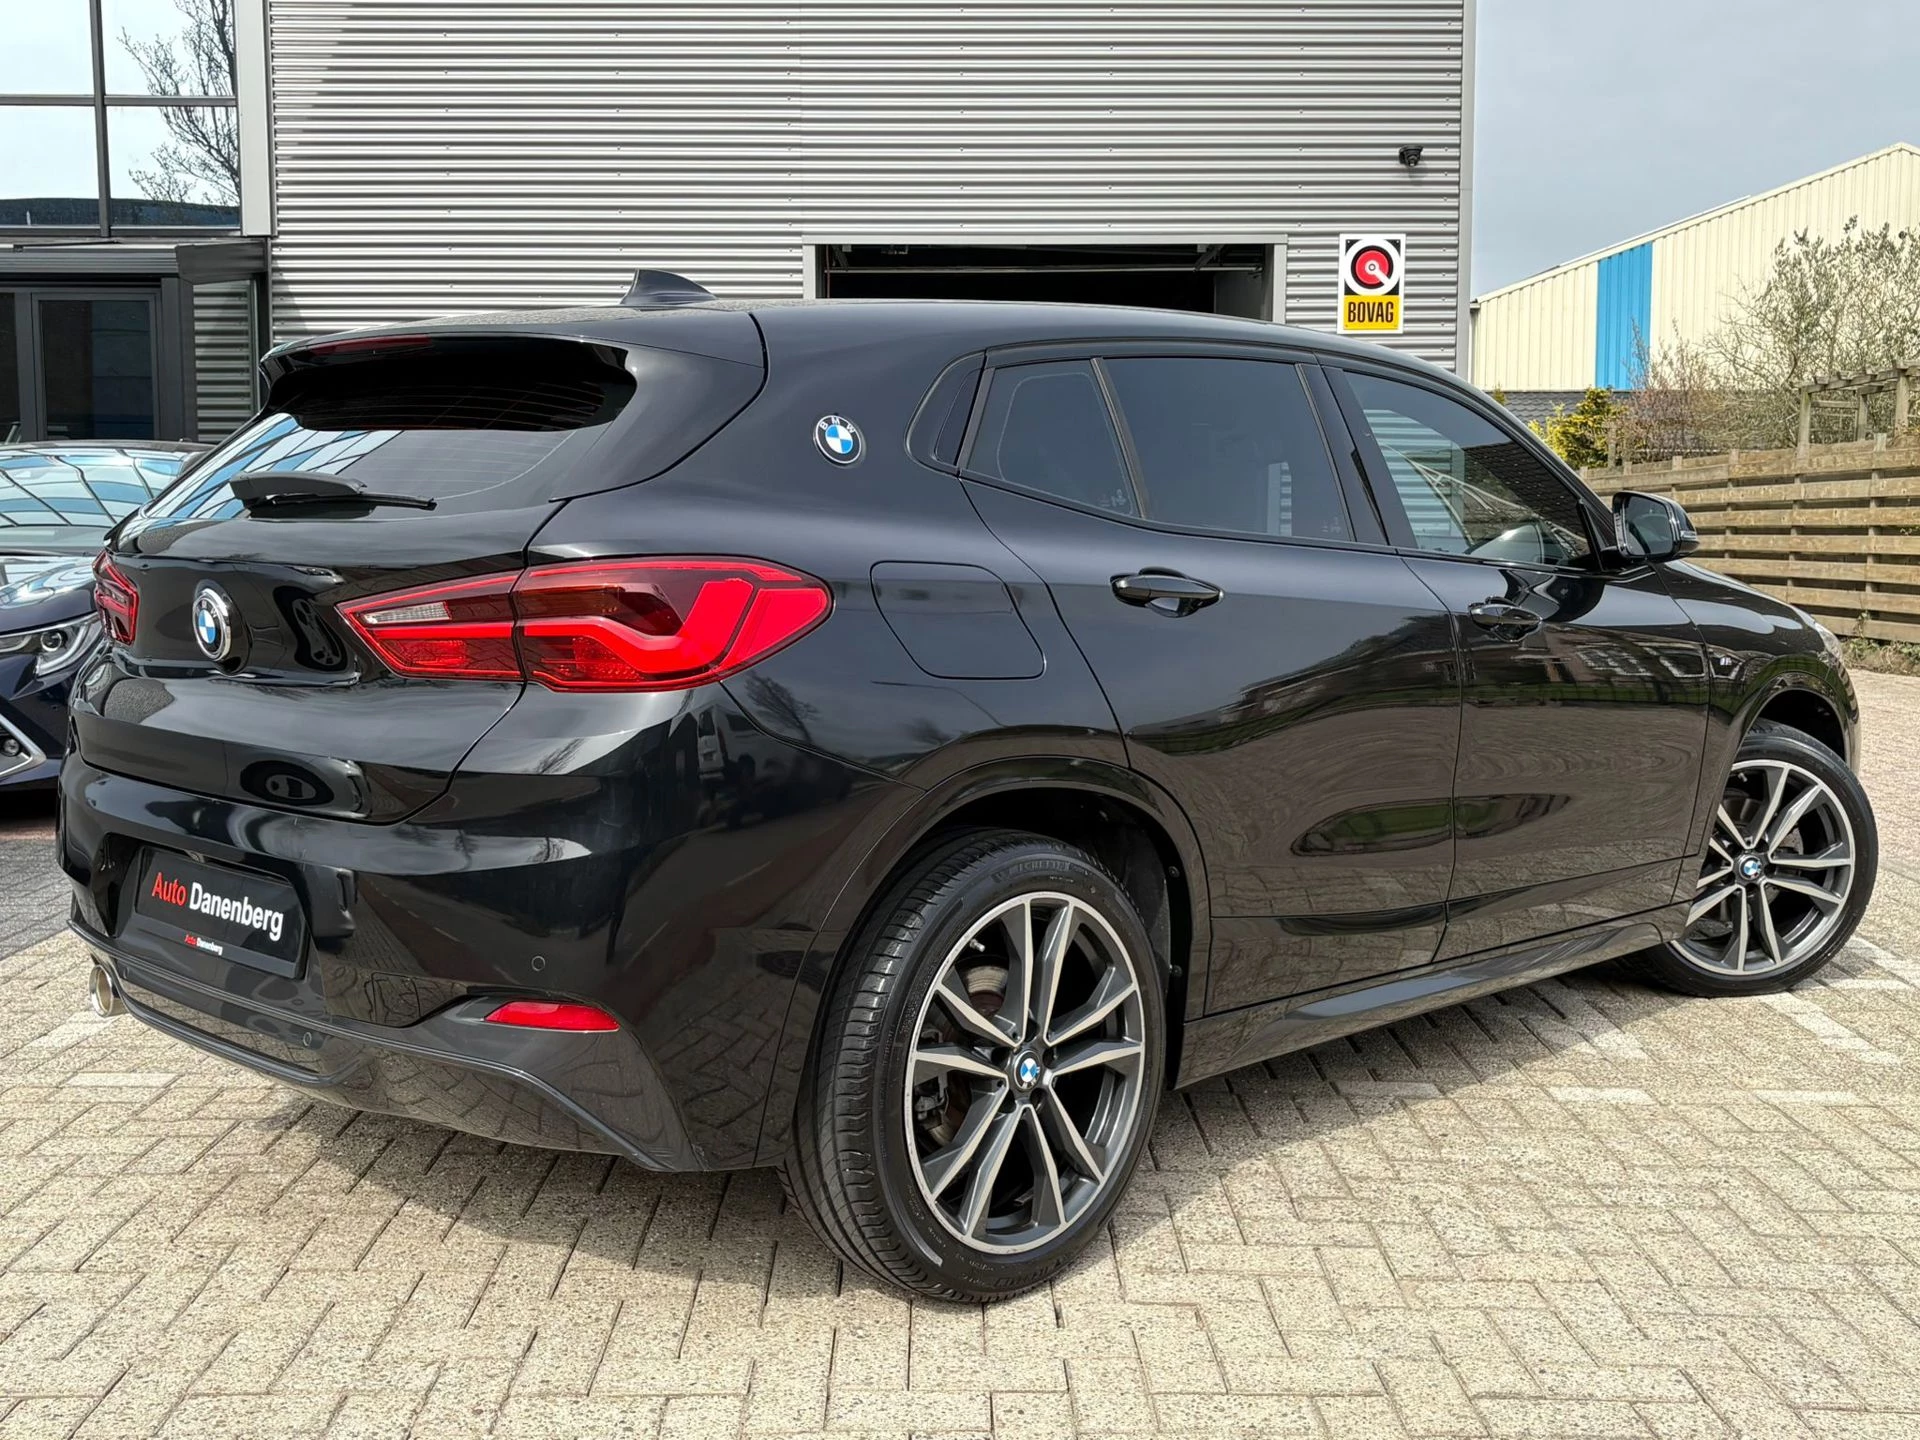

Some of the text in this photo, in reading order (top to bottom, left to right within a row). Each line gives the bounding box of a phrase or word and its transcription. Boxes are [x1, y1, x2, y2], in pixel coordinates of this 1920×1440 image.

[1348, 301, 1394, 323] BOVAG
[152, 871, 284, 942] Auto Danenberg
